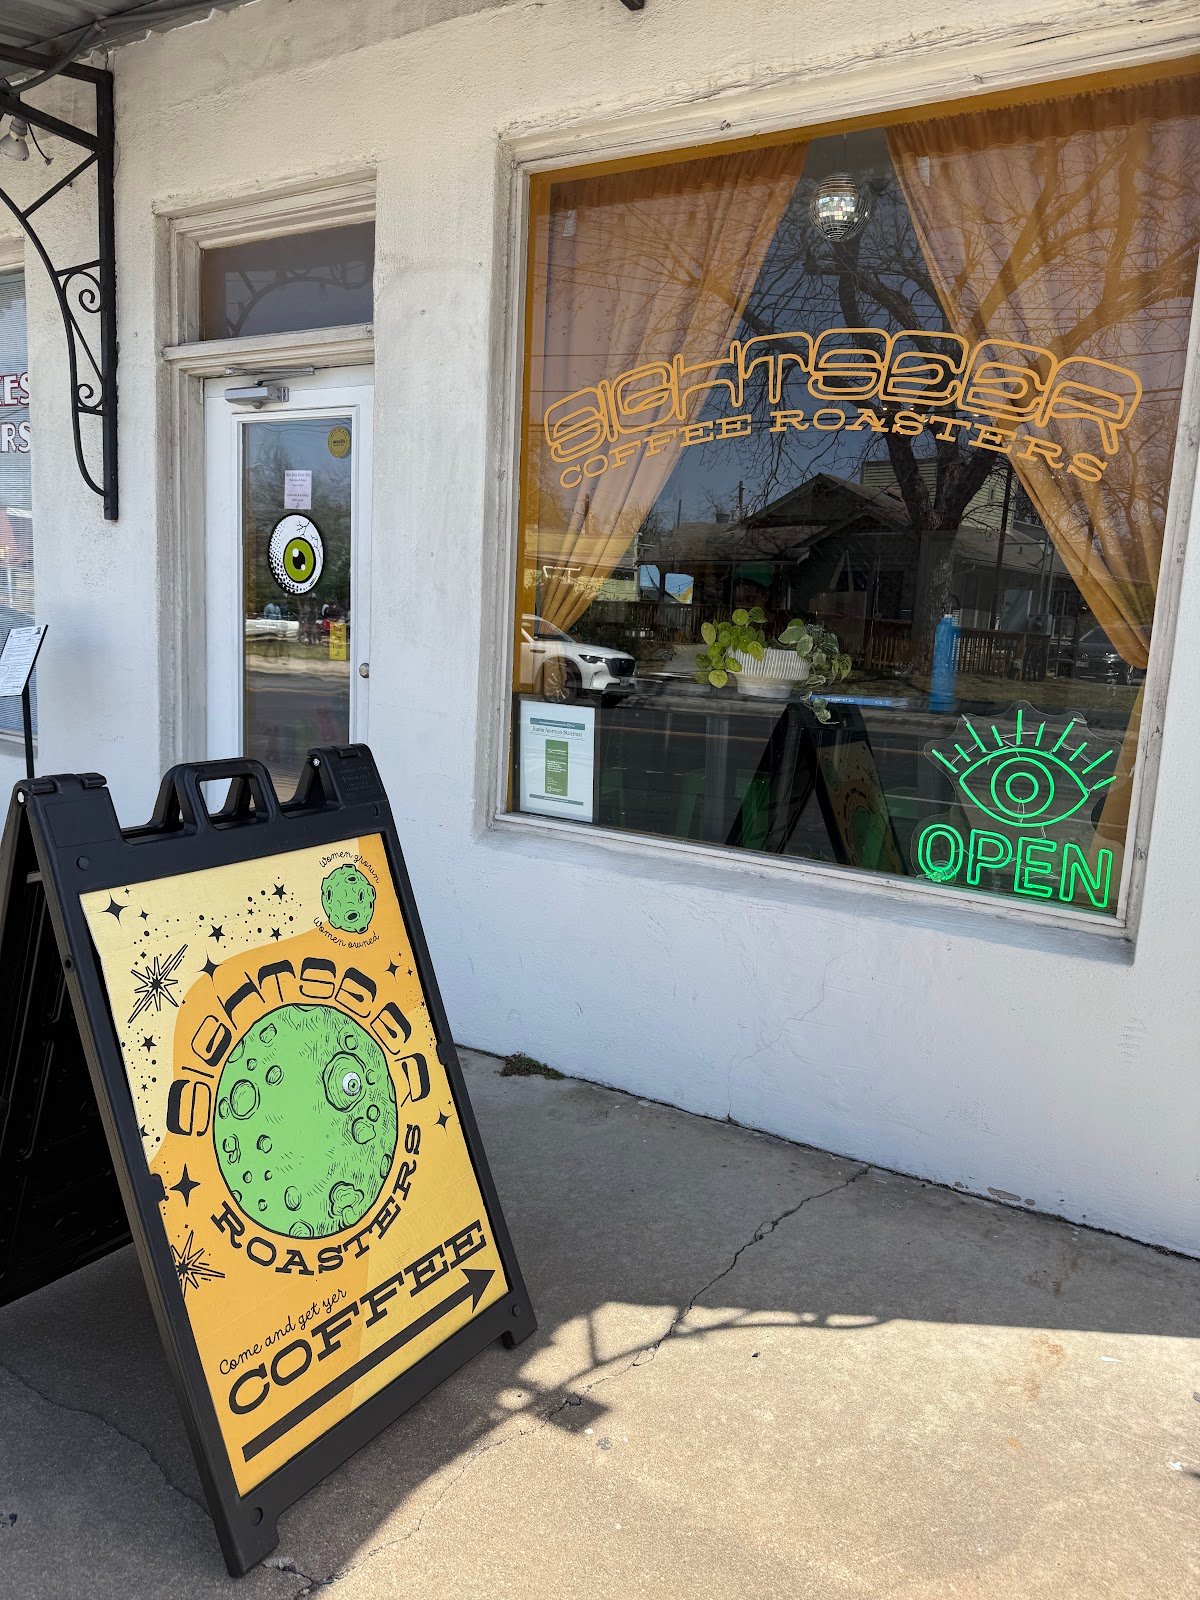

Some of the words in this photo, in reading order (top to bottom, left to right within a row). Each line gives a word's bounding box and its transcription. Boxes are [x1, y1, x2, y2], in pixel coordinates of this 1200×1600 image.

[0, 372, 29, 406] ES
[560, 414, 752, 489] COFFEE
[776, 408, 1108, 483] ROASTERS
[354, 855, 379, 883] grown
[918, 824, 1113, 908] OPEN
[348, 931, 380, 948] owned
[210, 1124, 421, 1275] ROASTERS
[220, 1343, 263, 1375] Come
[264, 1315, 296, 1346] and
[298, 1302, 321, 1330] get
[322, 1289, 347, 1313] yer
[229, 1219, 487, 1415] COFFEE
